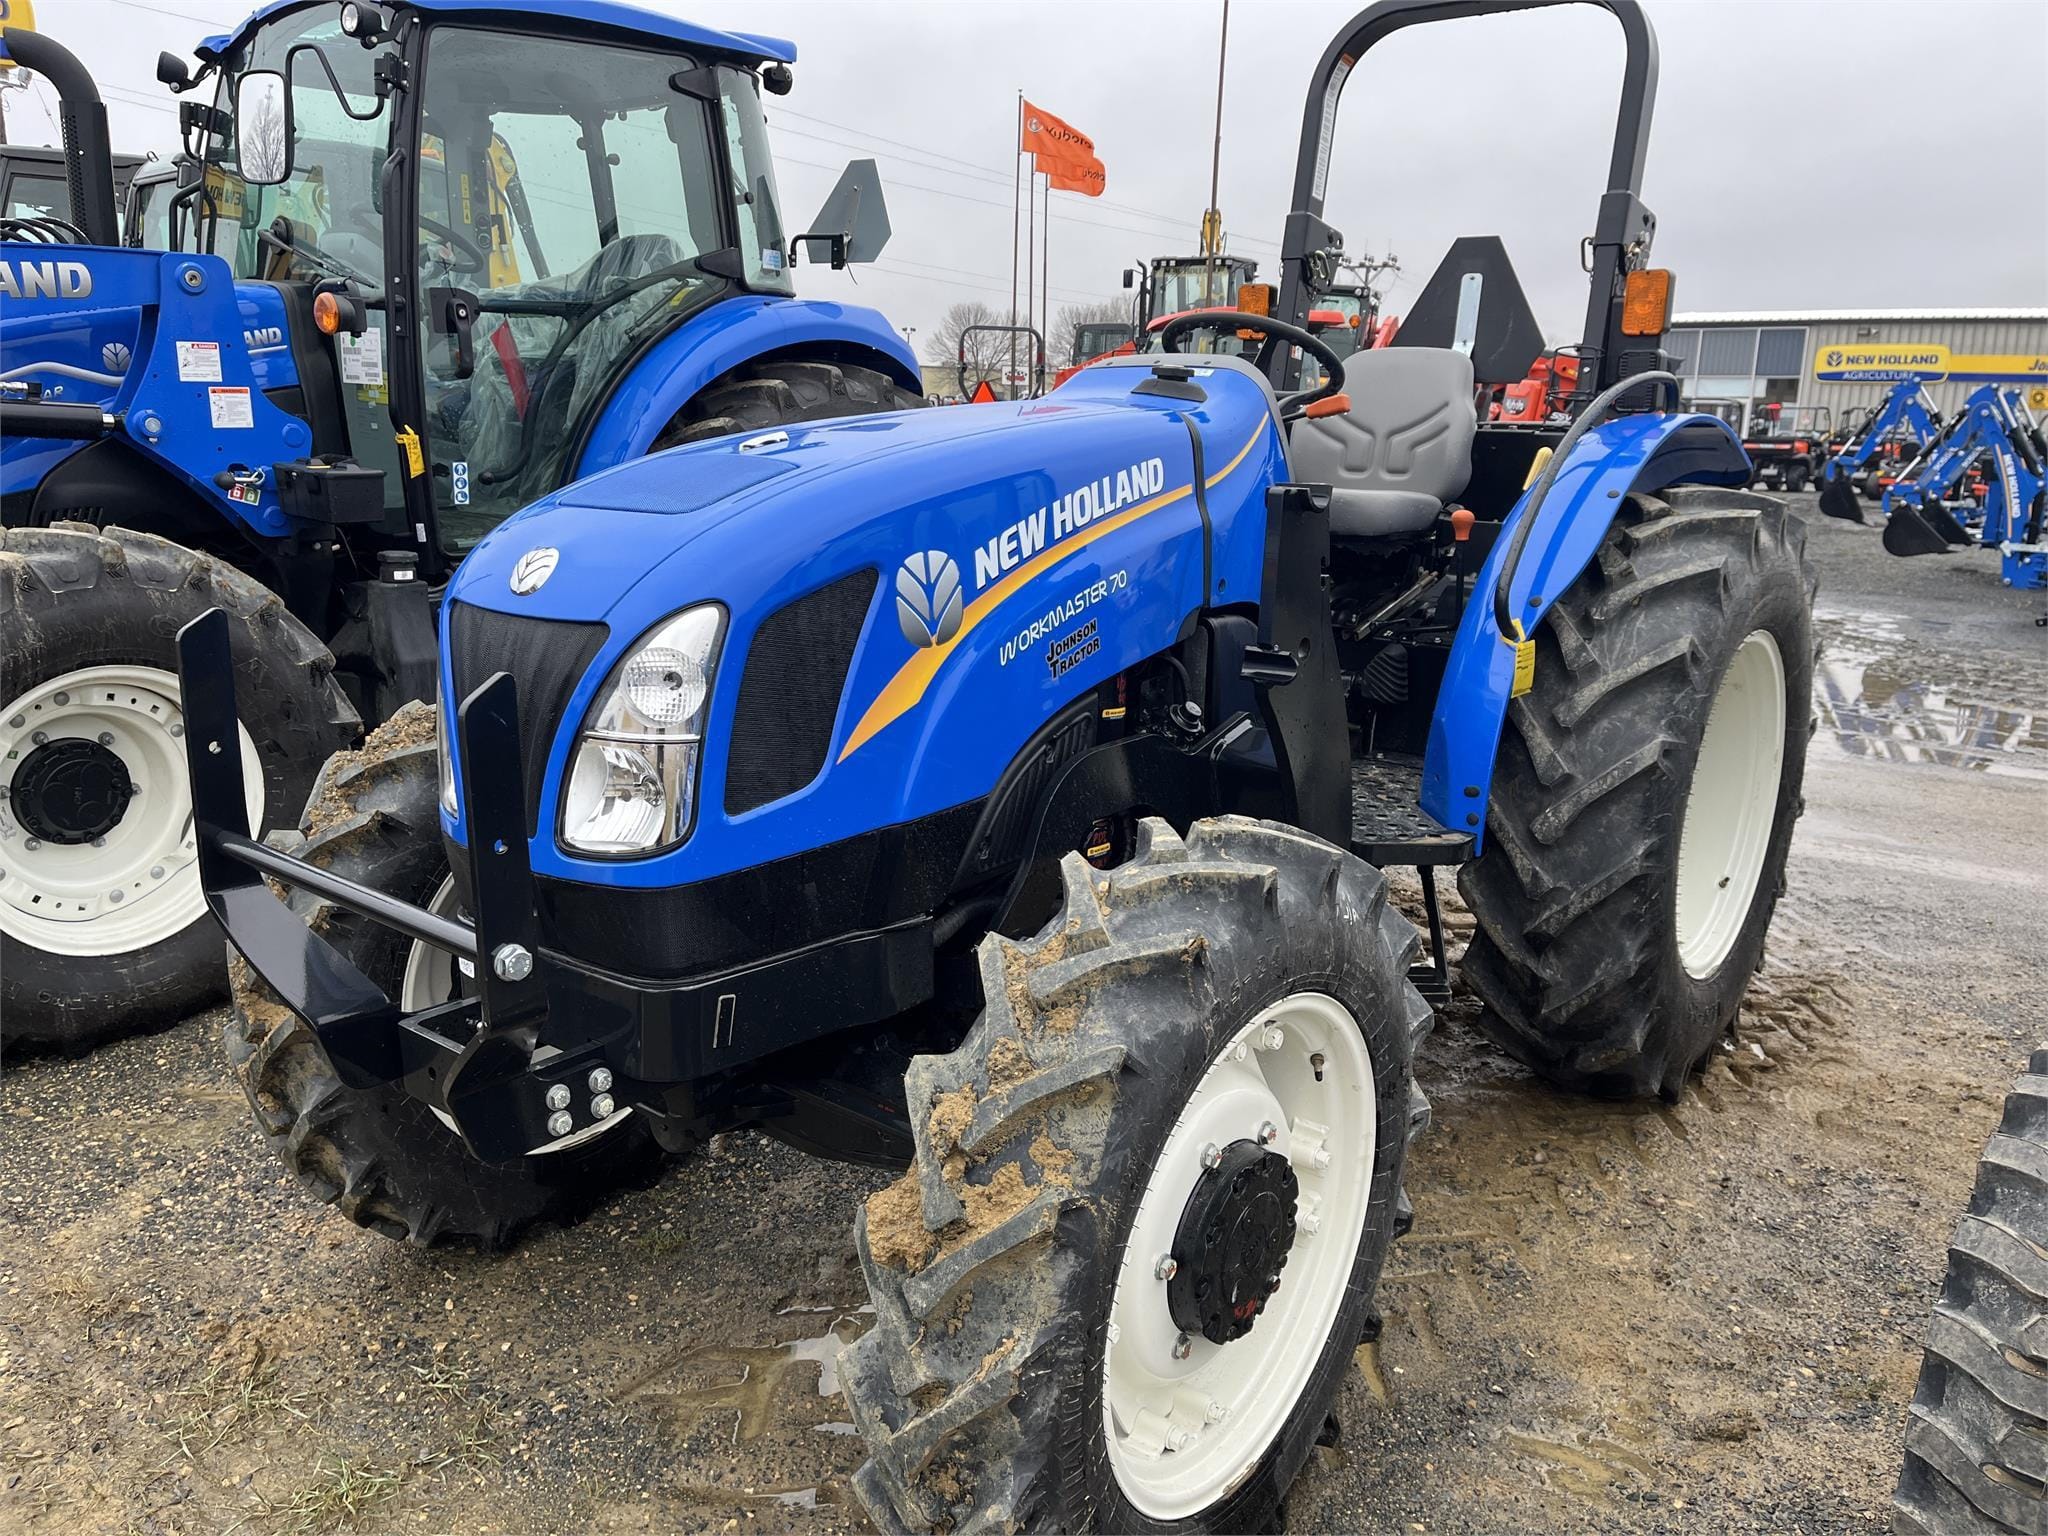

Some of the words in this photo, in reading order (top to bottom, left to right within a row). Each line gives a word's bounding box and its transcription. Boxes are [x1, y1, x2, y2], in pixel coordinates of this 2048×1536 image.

[1846, 355, 1875, 365] NEW
[1878, 355, 1939, 365] HOLLAND
[974, 507, 1047, 590] NEW
[1052, 457, 1164, 541] HOLLAND
[1000, 580, 1107, 666] WORKMASTER
[1109, 569, 1127, 593] 70
